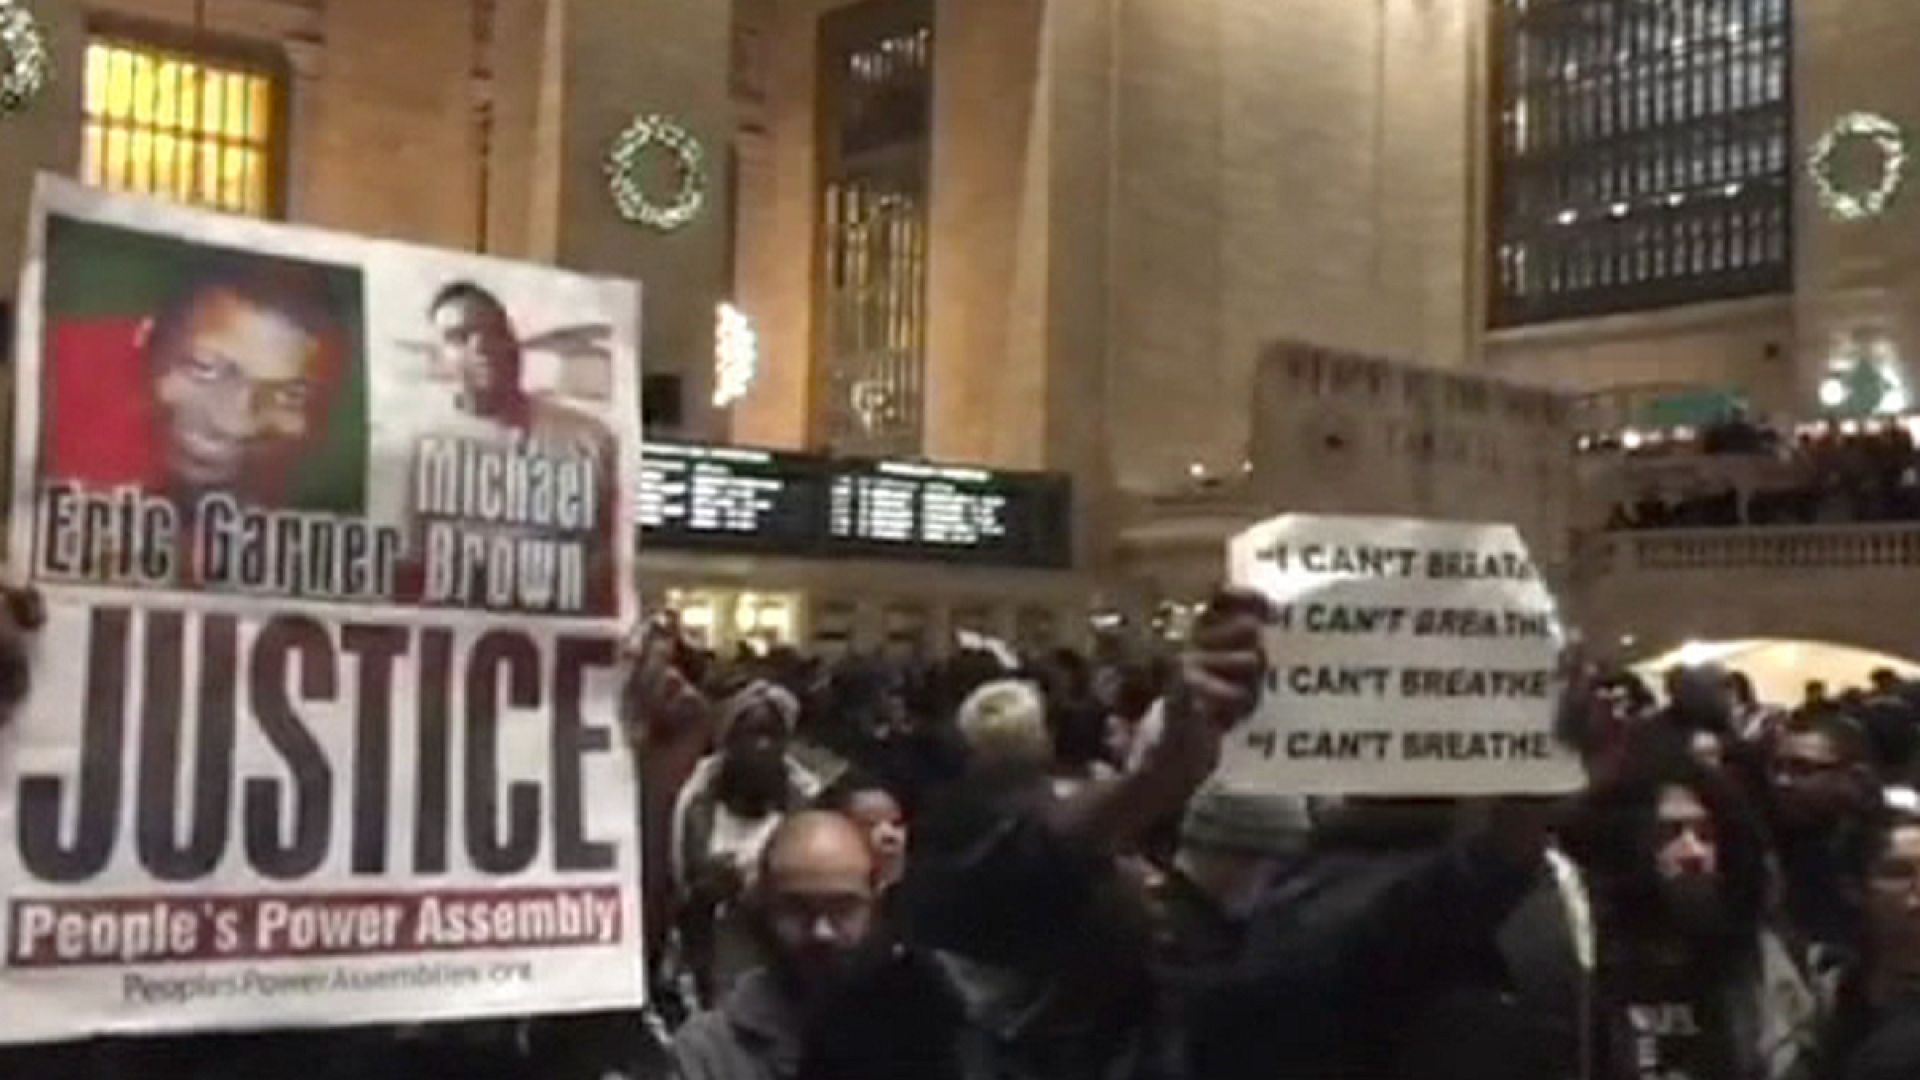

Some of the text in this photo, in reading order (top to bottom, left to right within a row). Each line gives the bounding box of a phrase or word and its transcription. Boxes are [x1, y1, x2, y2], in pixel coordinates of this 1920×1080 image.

[415, 436, 598, 529] Michael
[42, 482, 402, 597] Eric Garner
[422, 523, 585, 611] Brown
[1303, 544, 1416, 576] CAN'T
[1289, 666, 1391, 695] CAN'T
[17, 604, 617, 884] JUSTICE
[1287, 731, 1392, 760] CAN'T
[17, 893, 618, 963] People's Power Assembly
